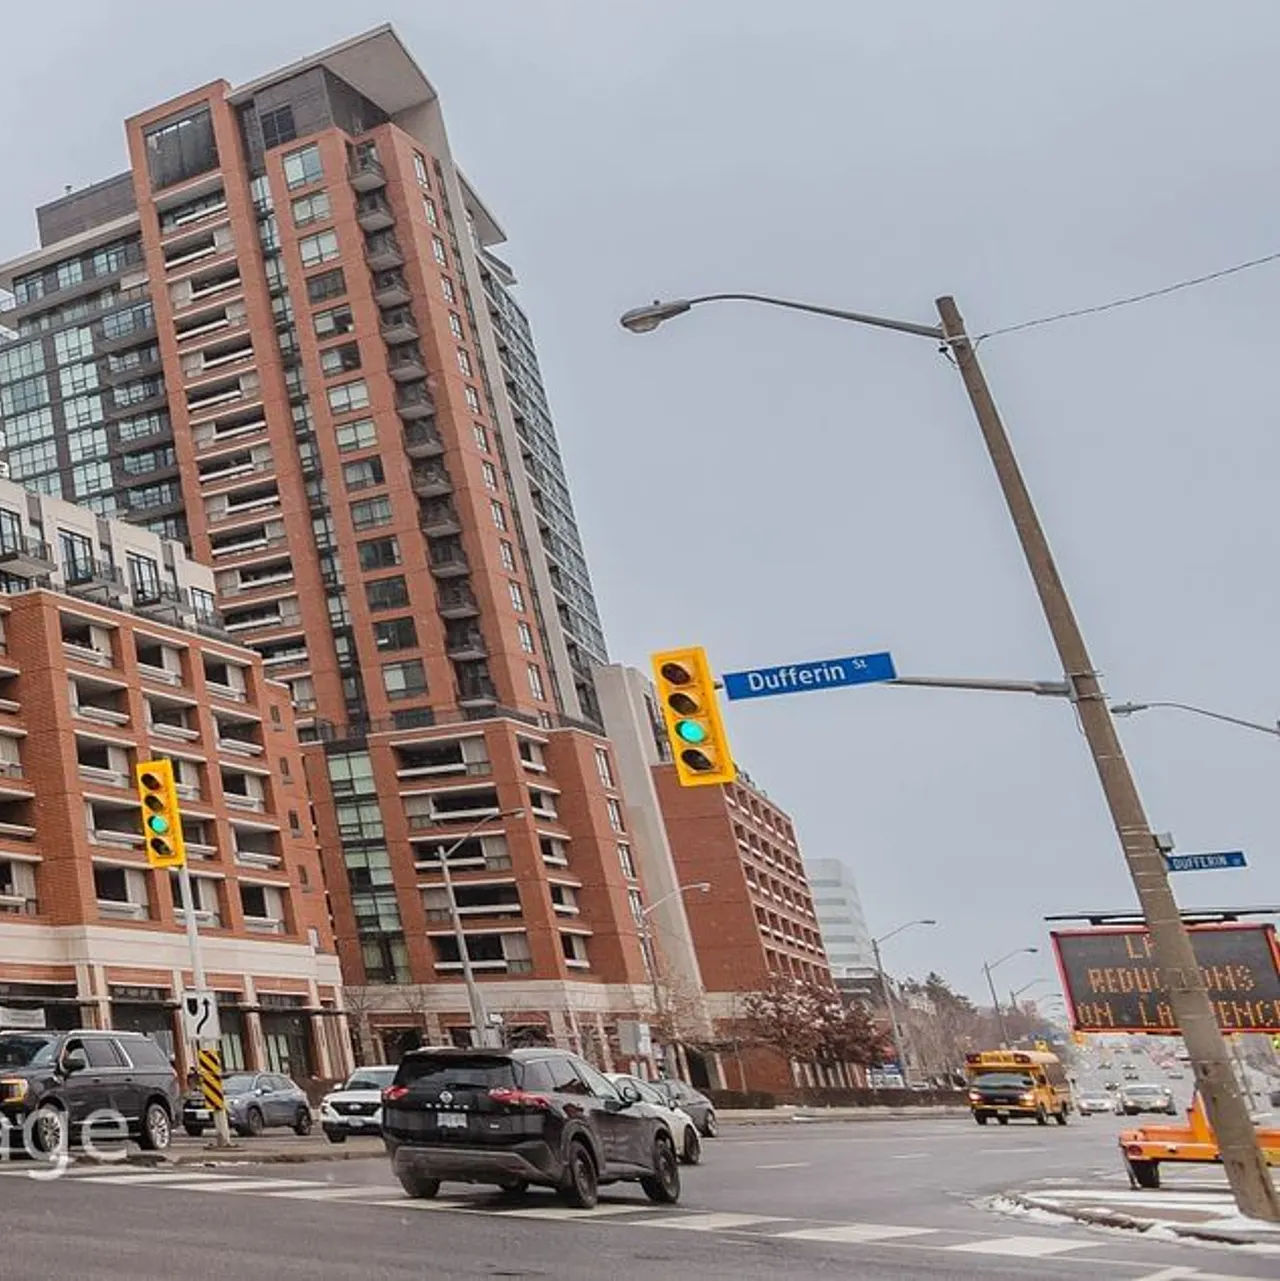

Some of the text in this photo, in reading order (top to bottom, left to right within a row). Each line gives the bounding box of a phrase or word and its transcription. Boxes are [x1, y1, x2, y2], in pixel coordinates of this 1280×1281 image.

[747, 657, 868, 691] Dufferin St
[1077, 1000, 1114, 1027] ON
